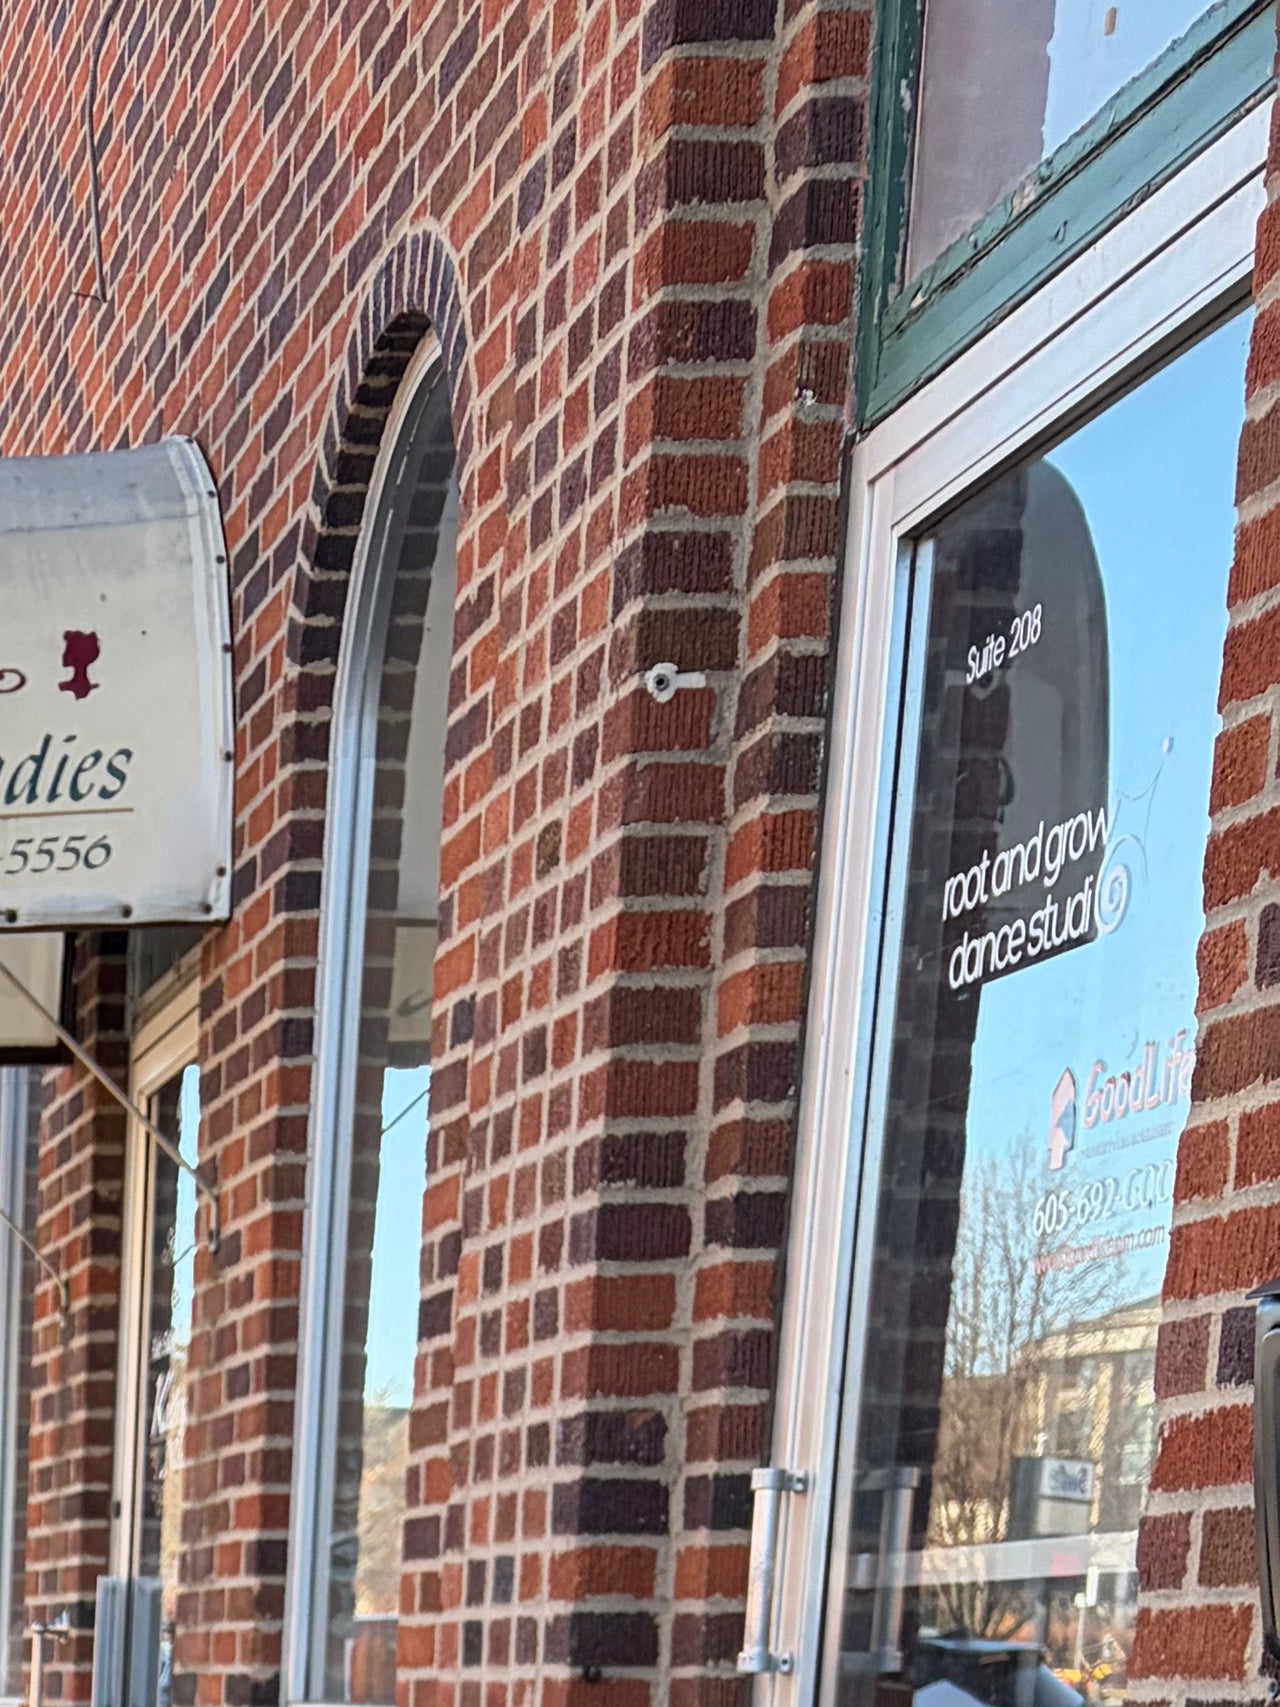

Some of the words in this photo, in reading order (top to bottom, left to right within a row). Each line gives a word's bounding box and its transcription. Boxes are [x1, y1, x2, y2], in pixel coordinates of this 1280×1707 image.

[965, 633, 1006, 685] Suite
[1007, 603, 1043, 658] 208
[942, 848, 991, 922] root
[991, 820, 1045, 898] and
[1043, 797, 1109, 888] grow
[949, 931, 1027, 990] dance
[1082, 1028, 1196, 1130] GoodLife
